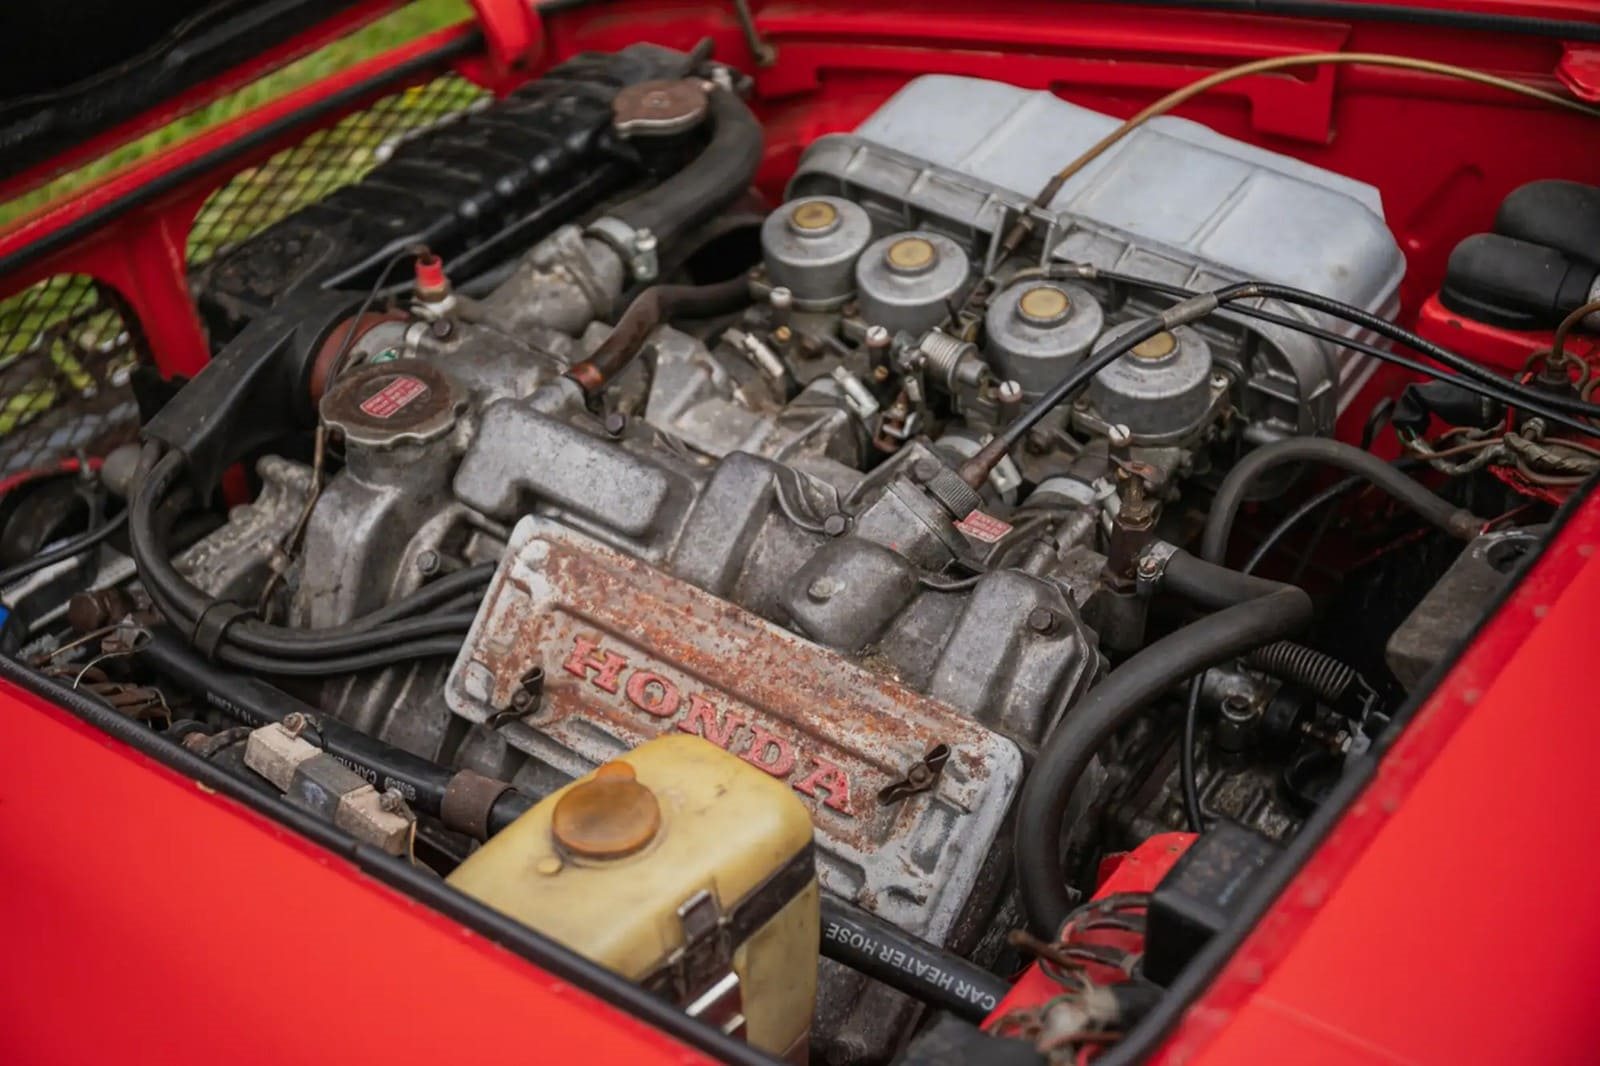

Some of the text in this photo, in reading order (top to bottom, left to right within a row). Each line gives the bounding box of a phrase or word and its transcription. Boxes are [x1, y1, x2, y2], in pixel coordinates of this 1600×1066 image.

[563, 634, 854, 818] HONDA
[826, 922, 997, 1011] CAR HEATER HOSE
